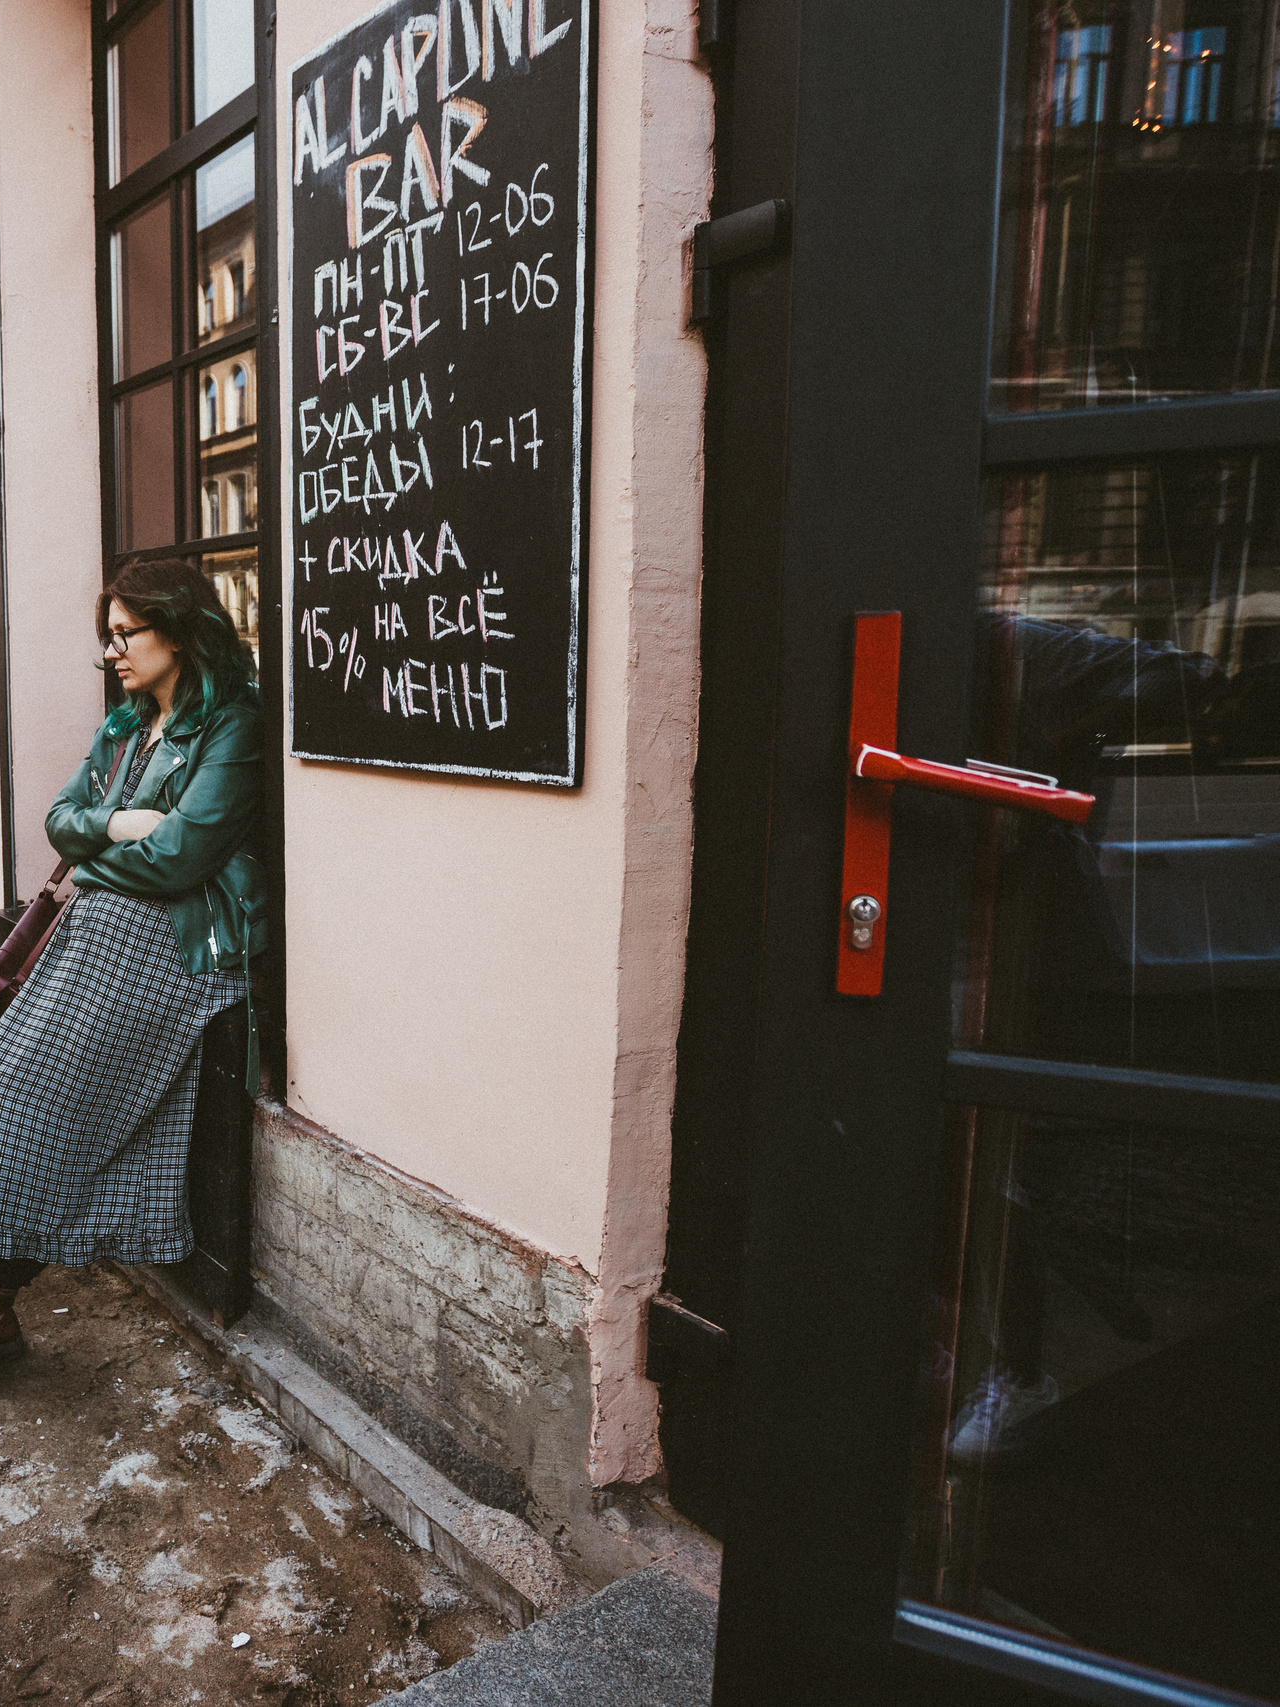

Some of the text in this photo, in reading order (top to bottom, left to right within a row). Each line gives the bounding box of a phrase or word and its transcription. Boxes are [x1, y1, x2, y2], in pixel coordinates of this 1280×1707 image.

[346, 94, 491, 249] BAR
[457, 163, 555, 257] 12-06
[460, 253, 559, 330] 17-06
[298, 408, 545, 525] ОБЕДЫ 12-17
[327, 519, 468, 590] СКИДКА
[300, 571, 516, 693] 15% НА ВСЁ
[382, 659, 508, 731] МЕНЮ
